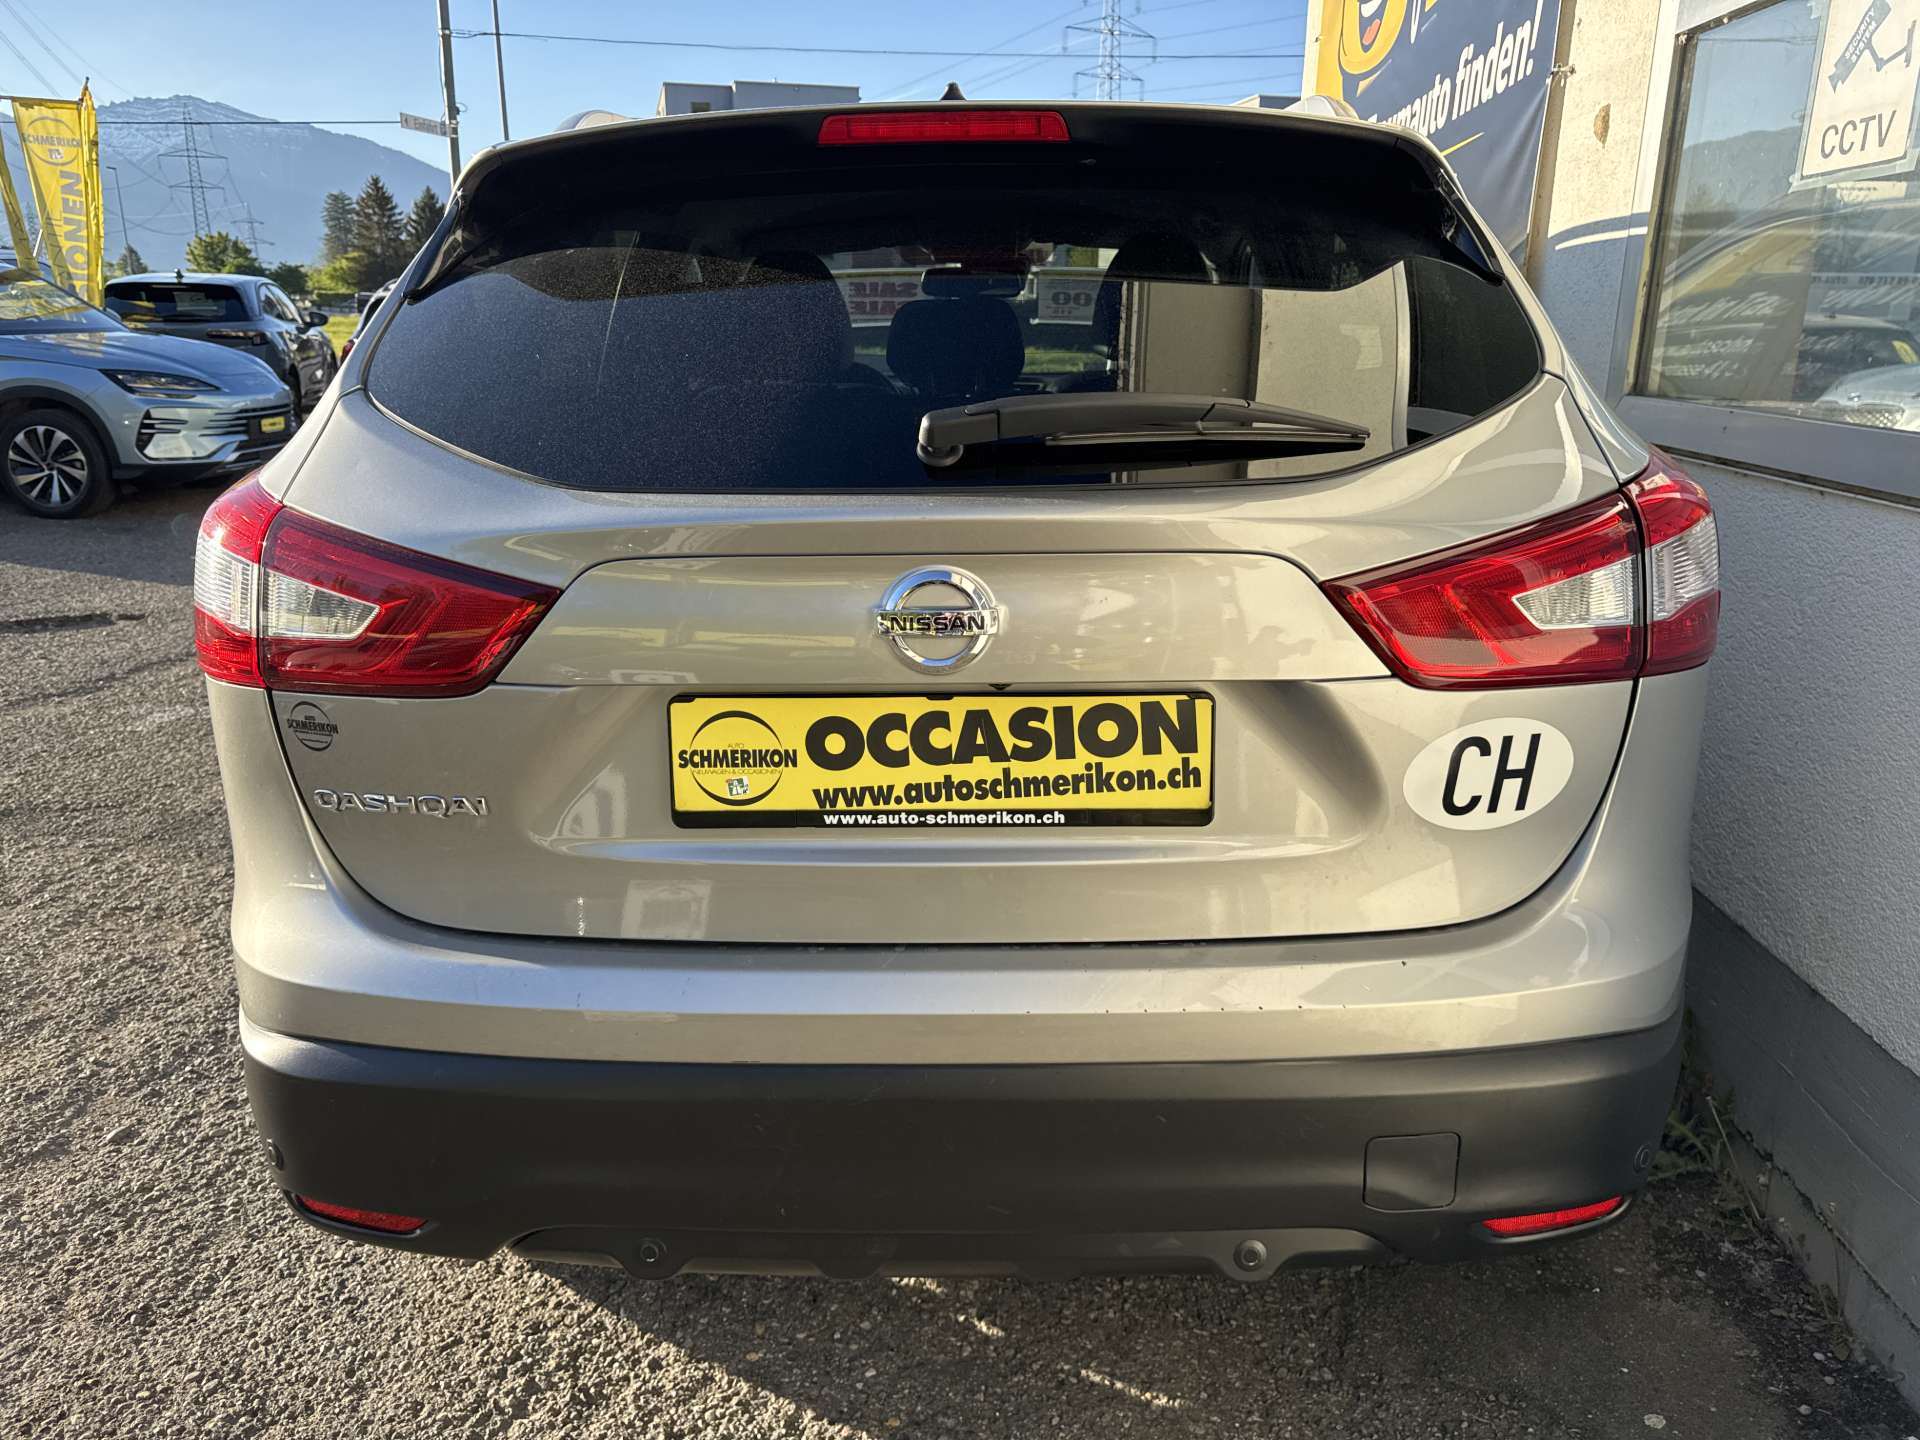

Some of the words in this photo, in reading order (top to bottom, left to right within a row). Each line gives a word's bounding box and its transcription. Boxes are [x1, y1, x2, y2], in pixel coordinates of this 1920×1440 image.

[1844, 7, 1874, 59] SECURITY
[1850, 20, 1878, 64] SYSTEM
[1452, 0, 1543, 120] finden!
[1820, 110, 1897, 159] CCTV
[890, 616, 985, 631] NISSAN
[678, 748, 798, 769] SCHMERIKON
[805, 699, 1198, 771] OCCASION
[812, 757, 1201, 809] www.autoschmerikon.ch
[1442, 733, 1541, 816] CH
[313, 789, 490, 819] QASHQAI
[823, 811, 1066, 825] www.auto-schmerikon.ch
